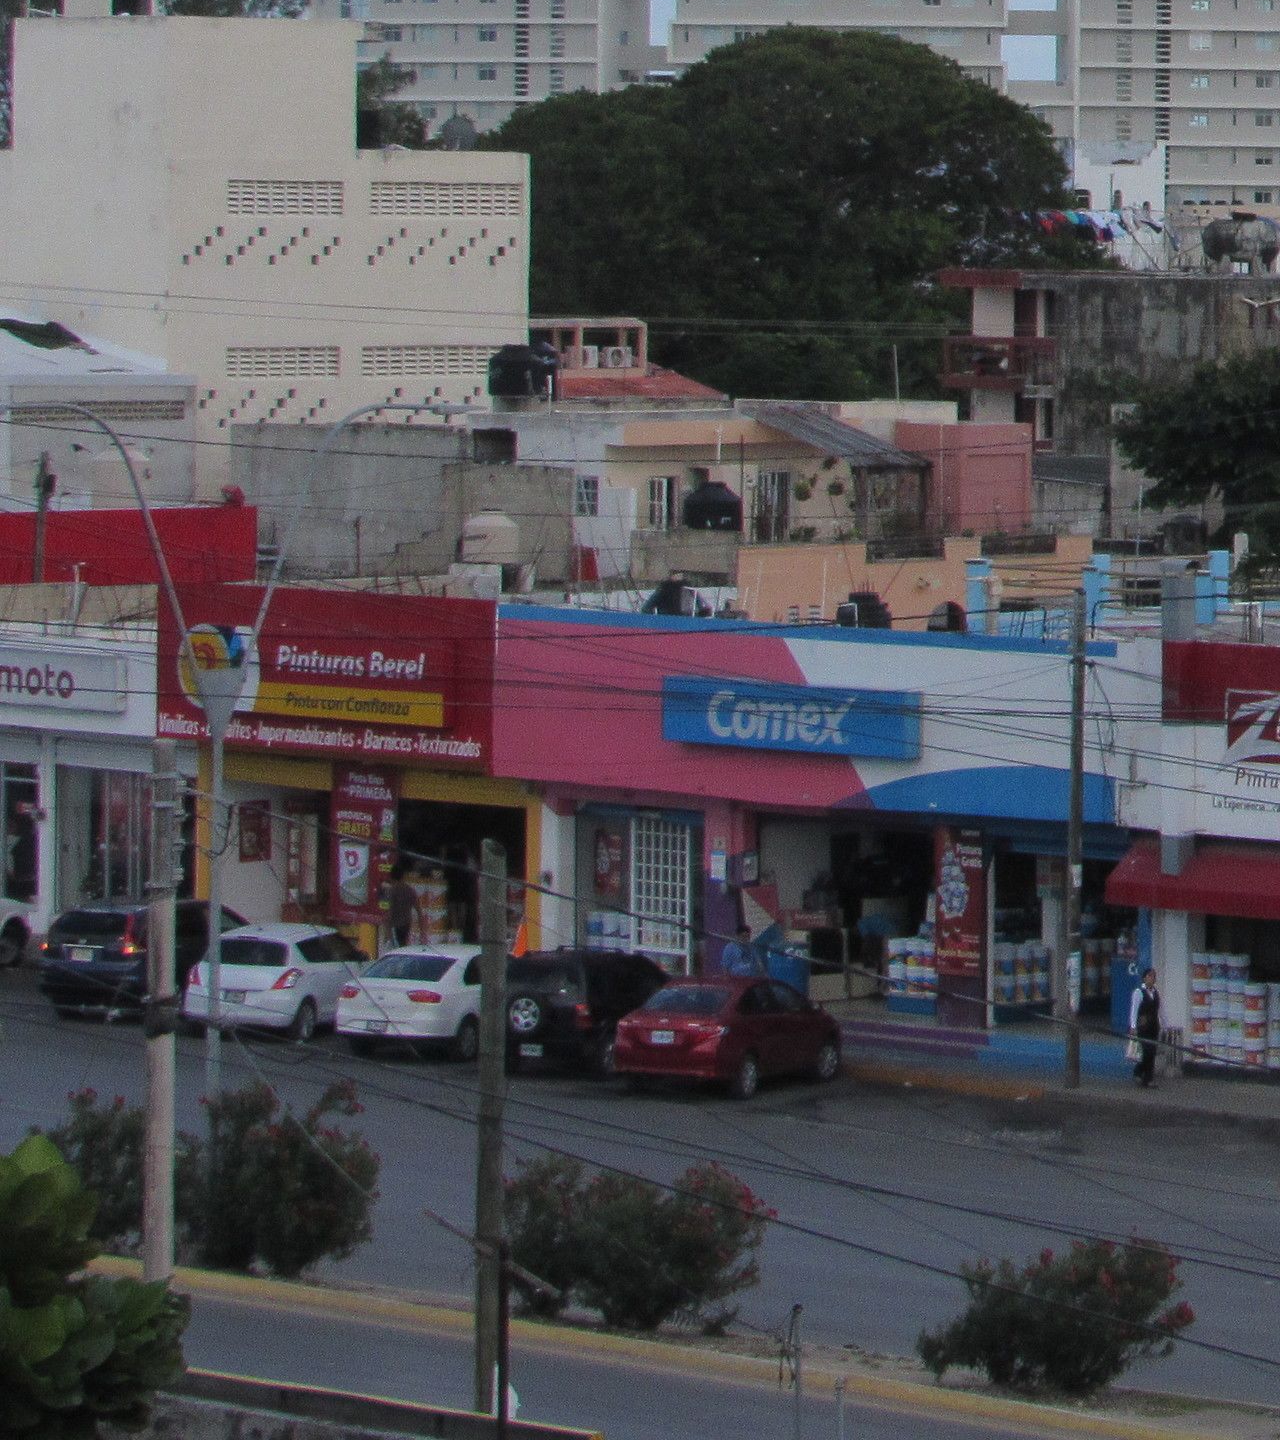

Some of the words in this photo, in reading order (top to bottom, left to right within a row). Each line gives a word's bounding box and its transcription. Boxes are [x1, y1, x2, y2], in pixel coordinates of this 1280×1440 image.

[277, 645, 364, 677] Pinturas
[369, 651, 426, 680] Berel
[707, 690, 857, 747] Comex
[362, 728, 412, 752] Barnices
[417, 732, 482, 758] Texturizados
